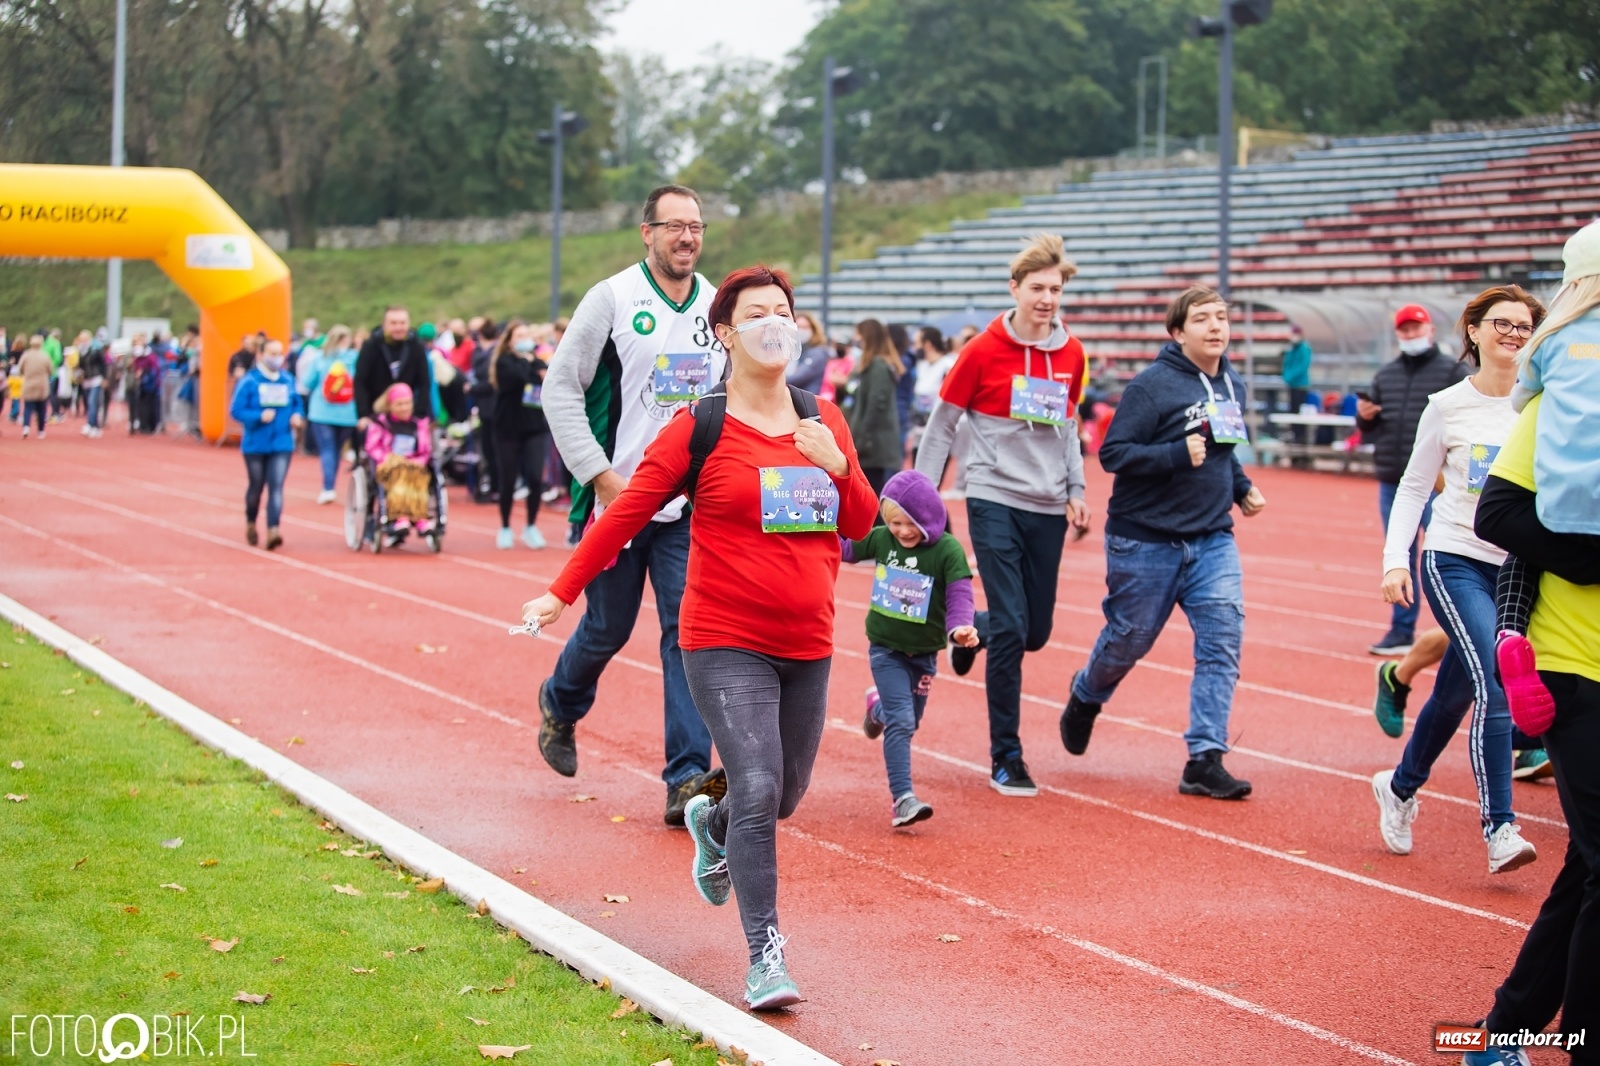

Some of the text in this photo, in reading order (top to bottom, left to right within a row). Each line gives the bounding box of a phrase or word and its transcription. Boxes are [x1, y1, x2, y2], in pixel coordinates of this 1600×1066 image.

[20, 203, 129, 224] RACIBÓRZ
[773, 490, 790, 499] BIEG
[794, 490, 808, 498] DLA
[812, 510, 833, 523] 042
[900, 603, 921, 617] 081
